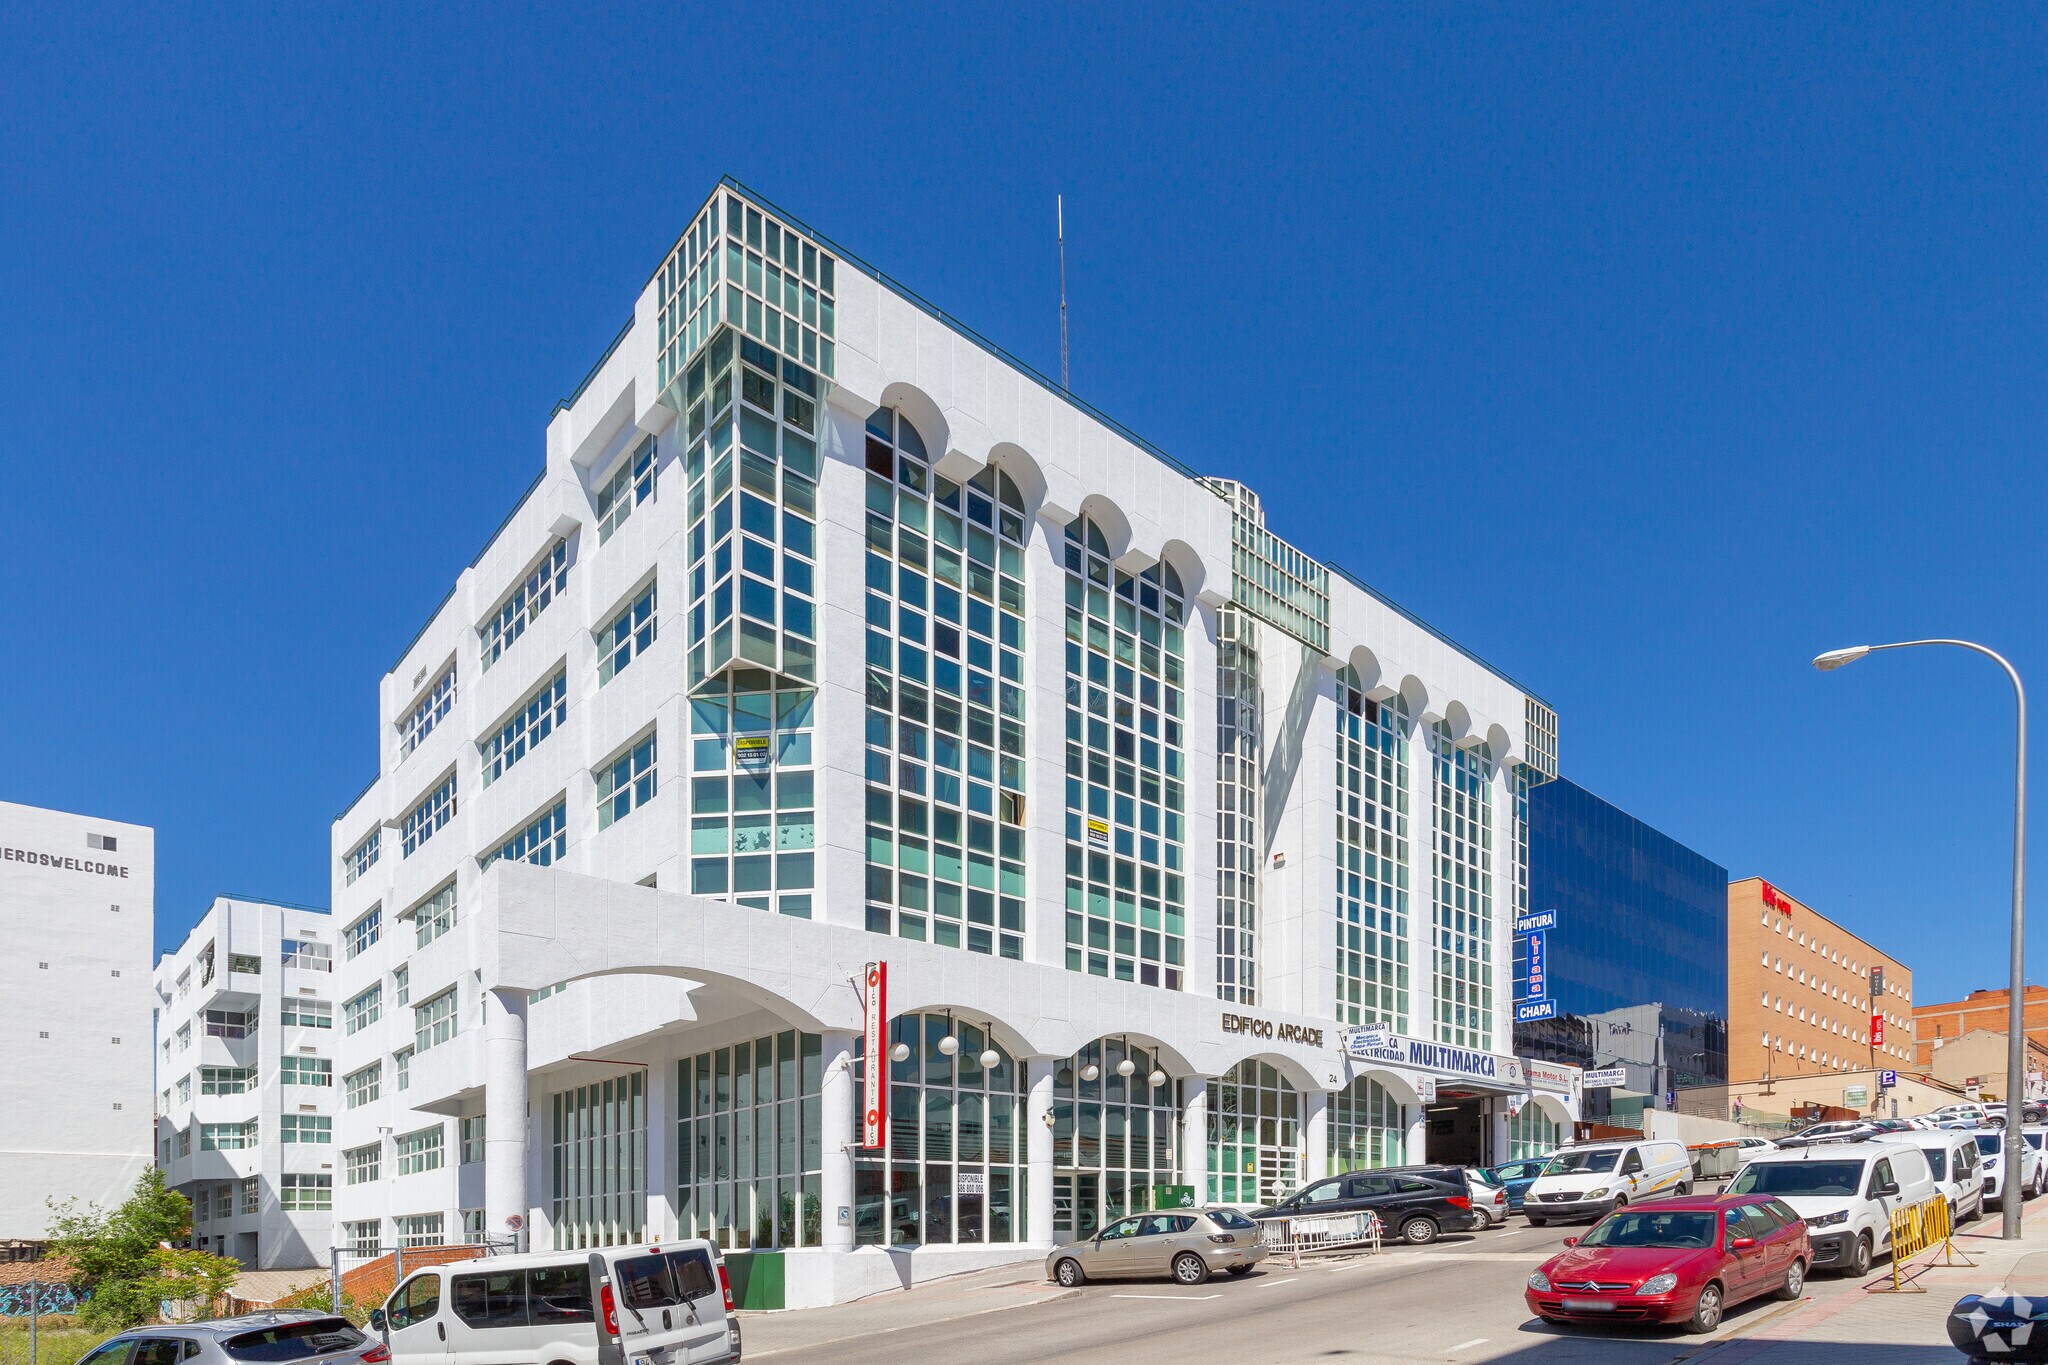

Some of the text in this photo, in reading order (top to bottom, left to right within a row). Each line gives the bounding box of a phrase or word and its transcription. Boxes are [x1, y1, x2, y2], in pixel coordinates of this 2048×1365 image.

[0, 847, 129, 878] ERDSWELCOME
[1518, 913, 1553, 931] PINTURA
[1530, 936, 1543, 992] Lirama
[1520, 1003, 1552, 1018] CHAPA
[1222, 1013, 1323, 1047] EDIFICIO ARCADE
[1348, 1023, 1386, 1034] MULTIMARCA
[1409, 1042, 1496, 1077] MULTIMARCA
[1328, 1074, 1338, 1083] 24
[1523, 1067, 1568, 1083] Lirama Motor S.L.
[1585, 1069, 1624, 1079] MULTIMARCA
[1883, 1071, 1894, 1083] P
